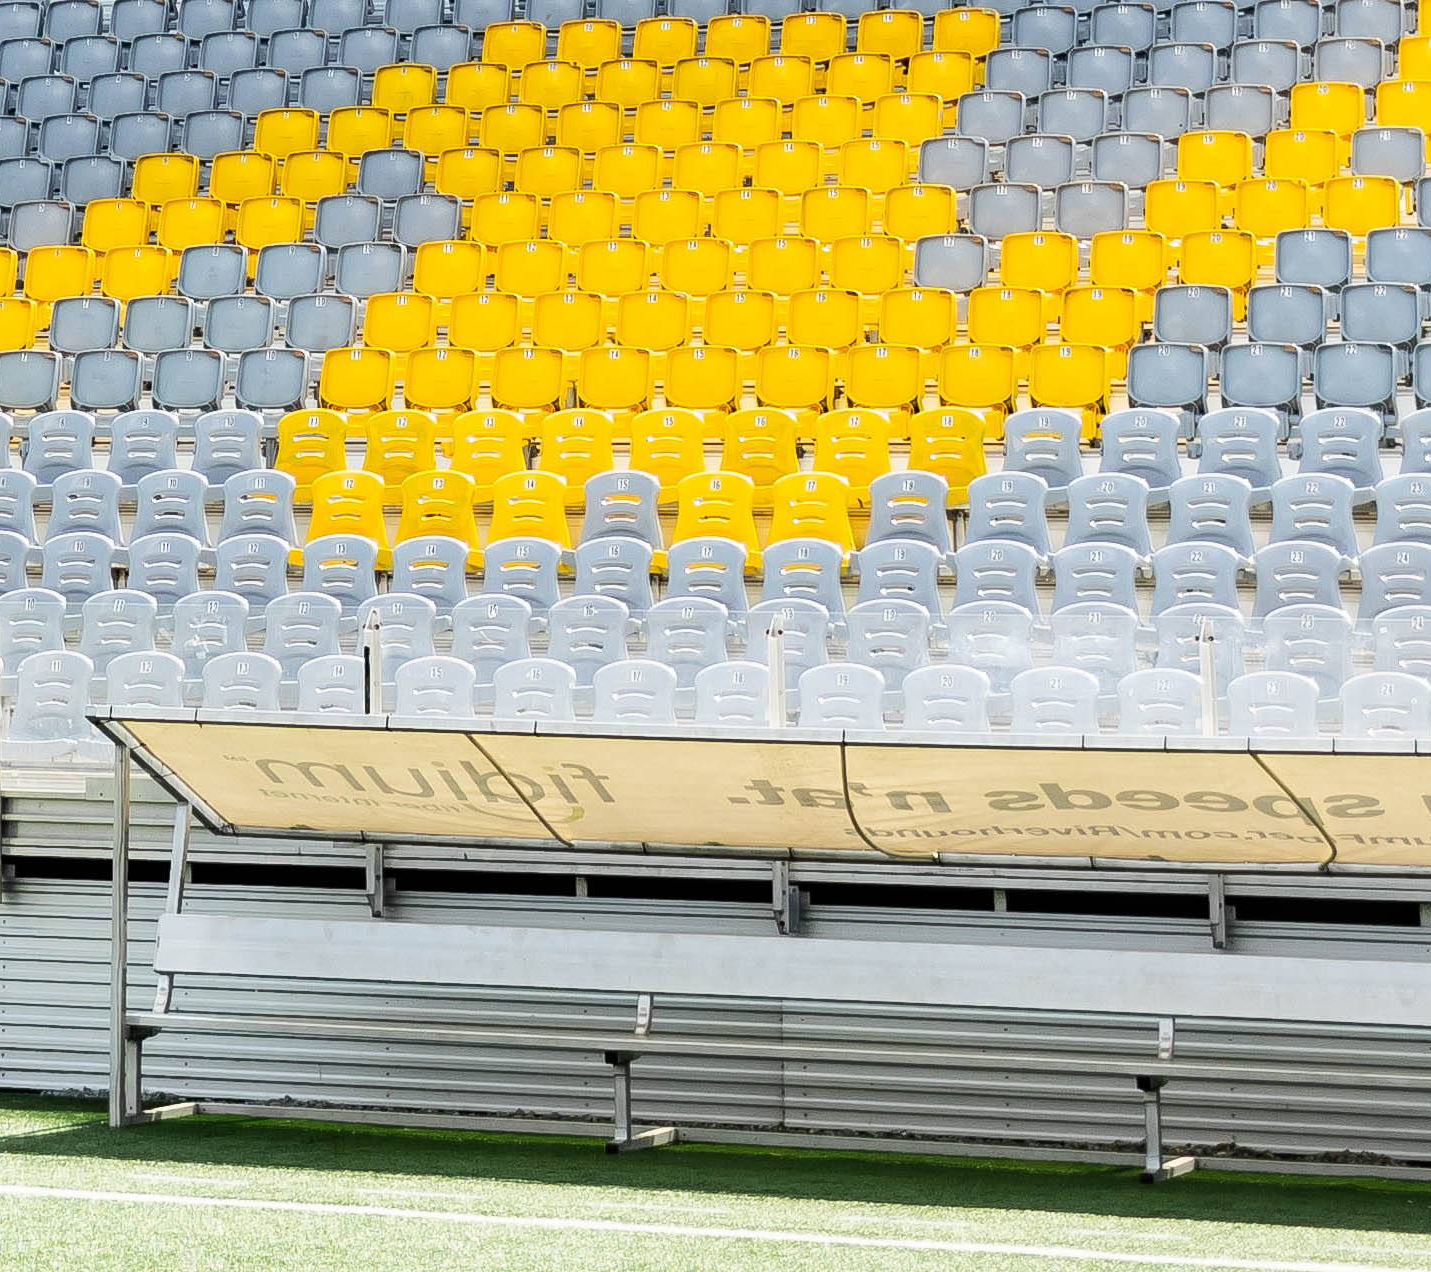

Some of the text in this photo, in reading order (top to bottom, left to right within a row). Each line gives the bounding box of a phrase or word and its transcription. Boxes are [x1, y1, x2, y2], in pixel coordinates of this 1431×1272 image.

[1266, 181, 1277, 192] 20
[1352, 179, 1365, 190] 21
[913, 188, 924, 197] 16
[1210, 233, 1223, 243] 20
[1304, 230, 1315, 240] 21
[1091, 289, 1103, 300] 19
[1188, 286, 1201, 296] 20
[1281, 285, 1292, 295] 21
[1375, 284, 1386, 294] 22
[912, 292, 922, 301] 17
[1001, 290, 1013, 300] 18
[876, 347, 888, 358] 17
[968, 347, 981, 358] 18
[1060, 346, 1072, 358] 19
[1159, 342, 1170, 354] 20
[1251, 343, 1262, 355] 21
[1346, 342, 1357, 354] 22
[186, 352, 192, 361] 9
[266, 351, 276, 360] 10
[436, 350, 448, 360] 12
[572, 416, 584, 427] 14
[662, 416, 675, 427] 15
[754, 416, 766, 427] 16
[848, 416, 860, 427] 17
[942, 415, 954, 427] 18
[1039, 417, 1050, 429] 19
[1135, 416, 1147, 428] 20
[1234, 416, 1246, 427] 21
[1334, 416, 1346, 428] 22
[168, 478, 178, 488] 10
[255, 479, 265, 488] 11
[342, 478, 355, 489] 12
[432, 478, 444, 489] 13
[523, 479, 536, 490] 14
[618, 479, 628, 490] 15
[709, 479, 722, 491] 16
[804, 480, 817, 491] 17
[903, 480, 914, 491] 18
[1002, 481, 1013, 493] 19
[1102, 482, 1114, 493] 20
[1204, 483, 1215, 494] 21
[1306, 482, 1318, 494] 22
[1411, 483, 1423, 494] 23
[517, 546, 529, 558] 15
[609, 546, 620, 557] 16
[702, 548, 712, 558] 17
[799, 548, 809, 559] 18
[992, 550, 1003, 561] 20
[1090, 552, 1102, 562] 21
[1191, 552, 1202, 563] 22
[1291, 552, 1303, 563] 23
[1397, 552, 1409, 564] 24
